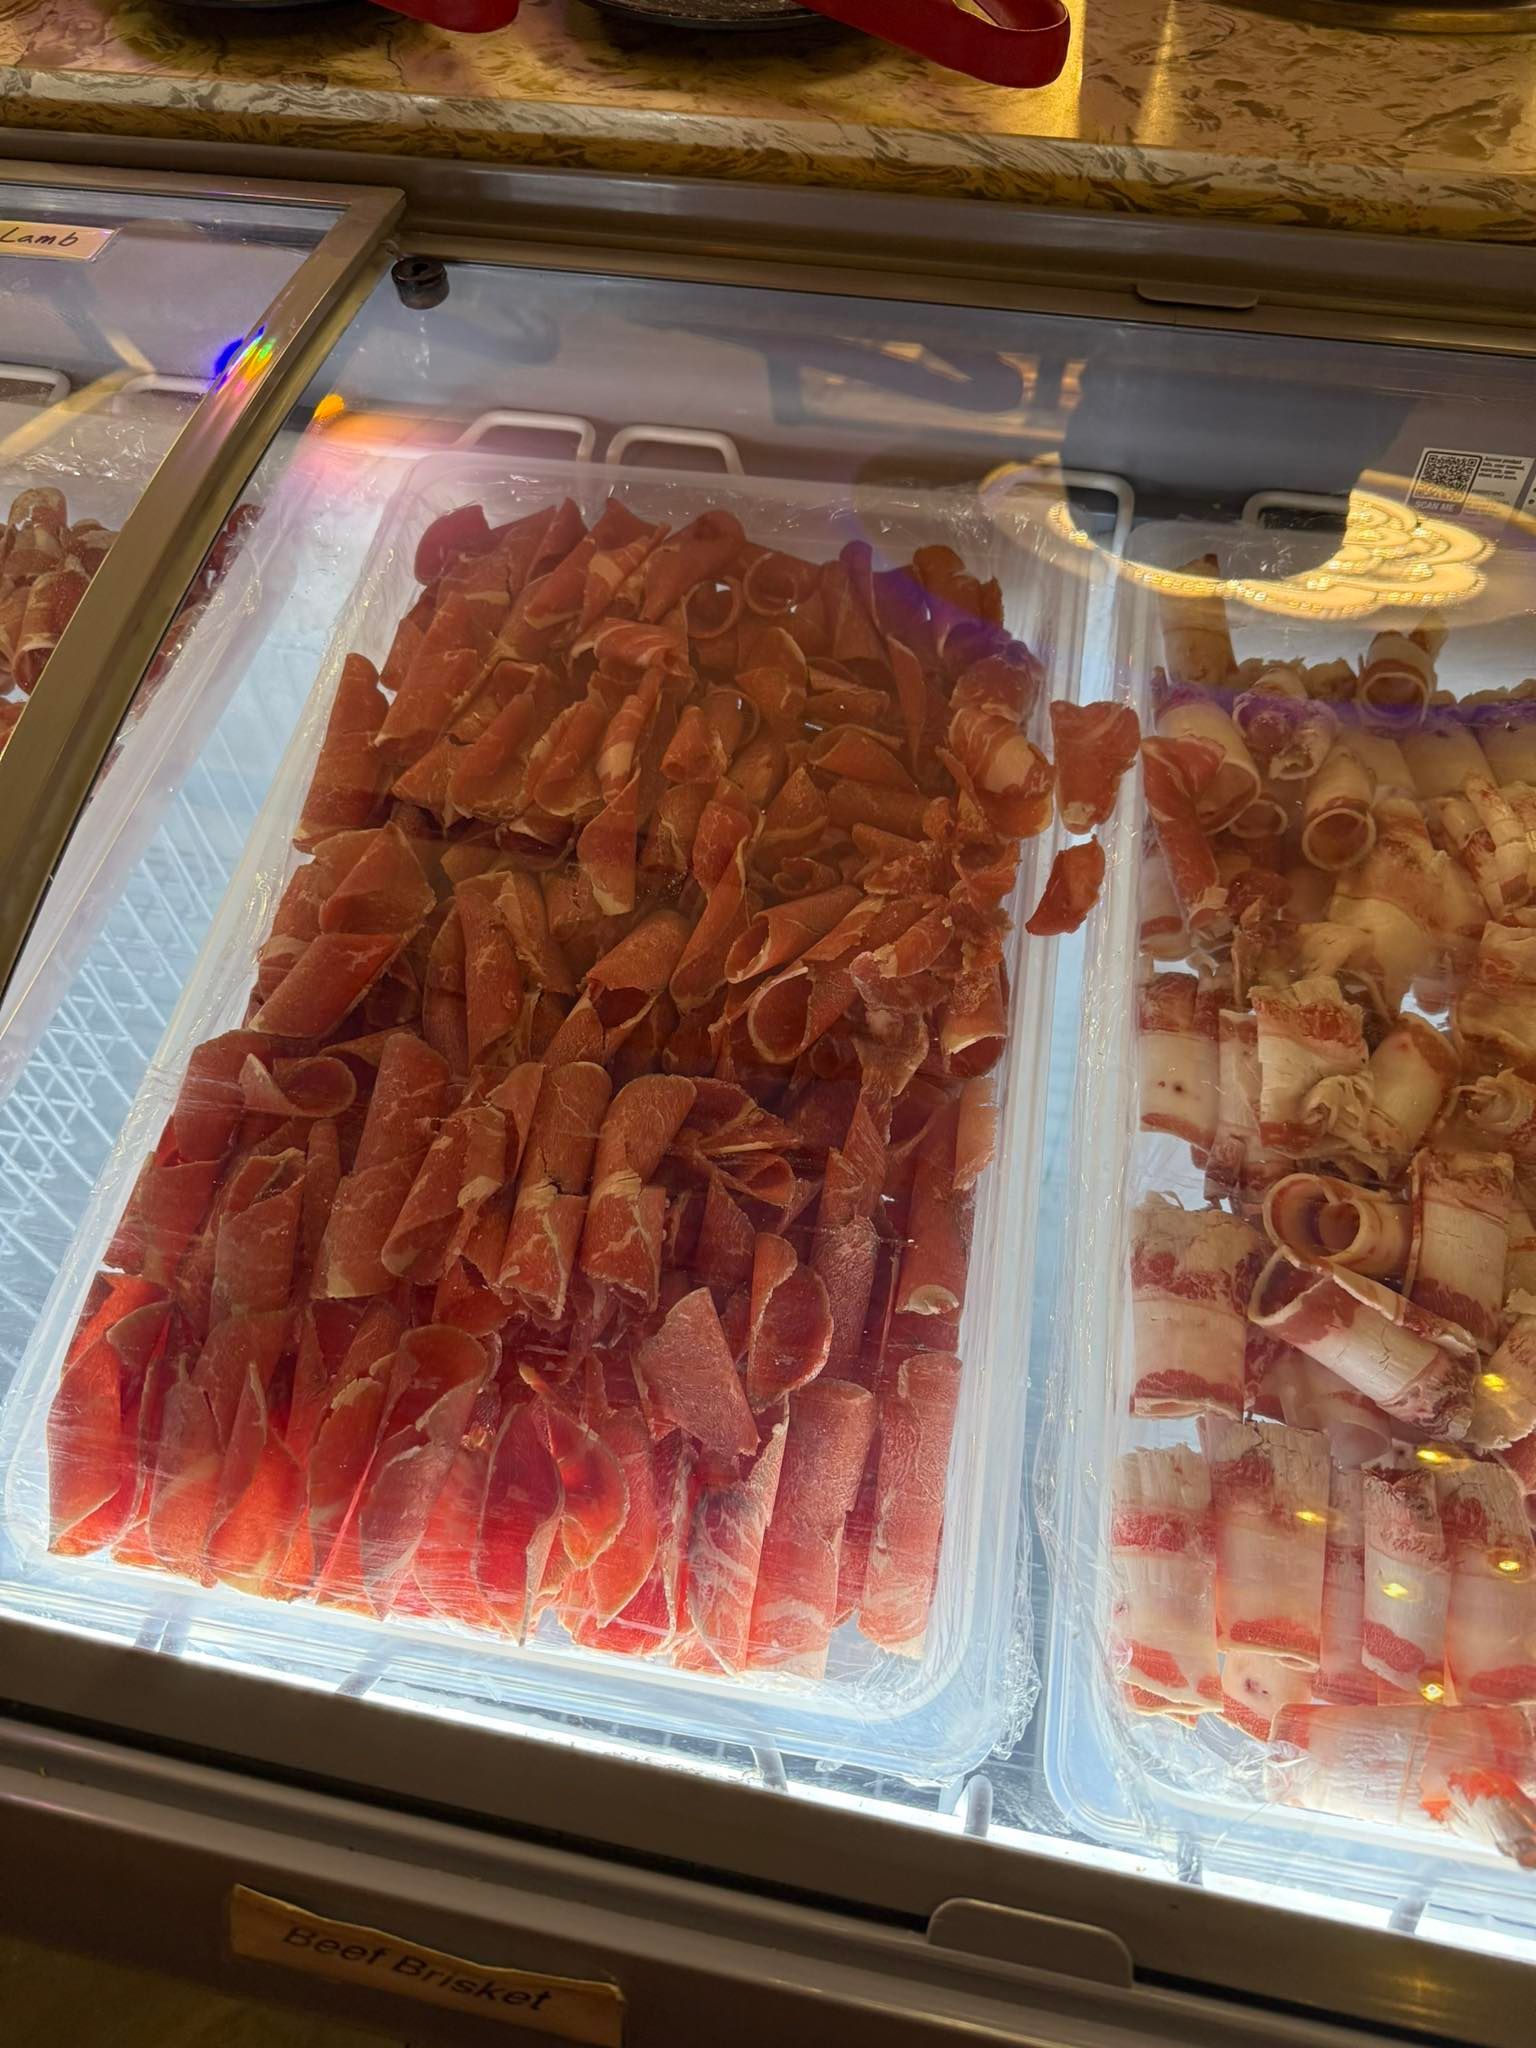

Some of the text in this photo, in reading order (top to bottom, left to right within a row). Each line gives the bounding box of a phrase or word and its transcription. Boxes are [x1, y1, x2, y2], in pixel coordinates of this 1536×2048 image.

[0, 227, 79, 246] Lamb
[1415, 501, 1440, 510] SCAN
[1440, 503, 1456, 512] ME
[282, 1925, 553, 2012] Beef Brisket
